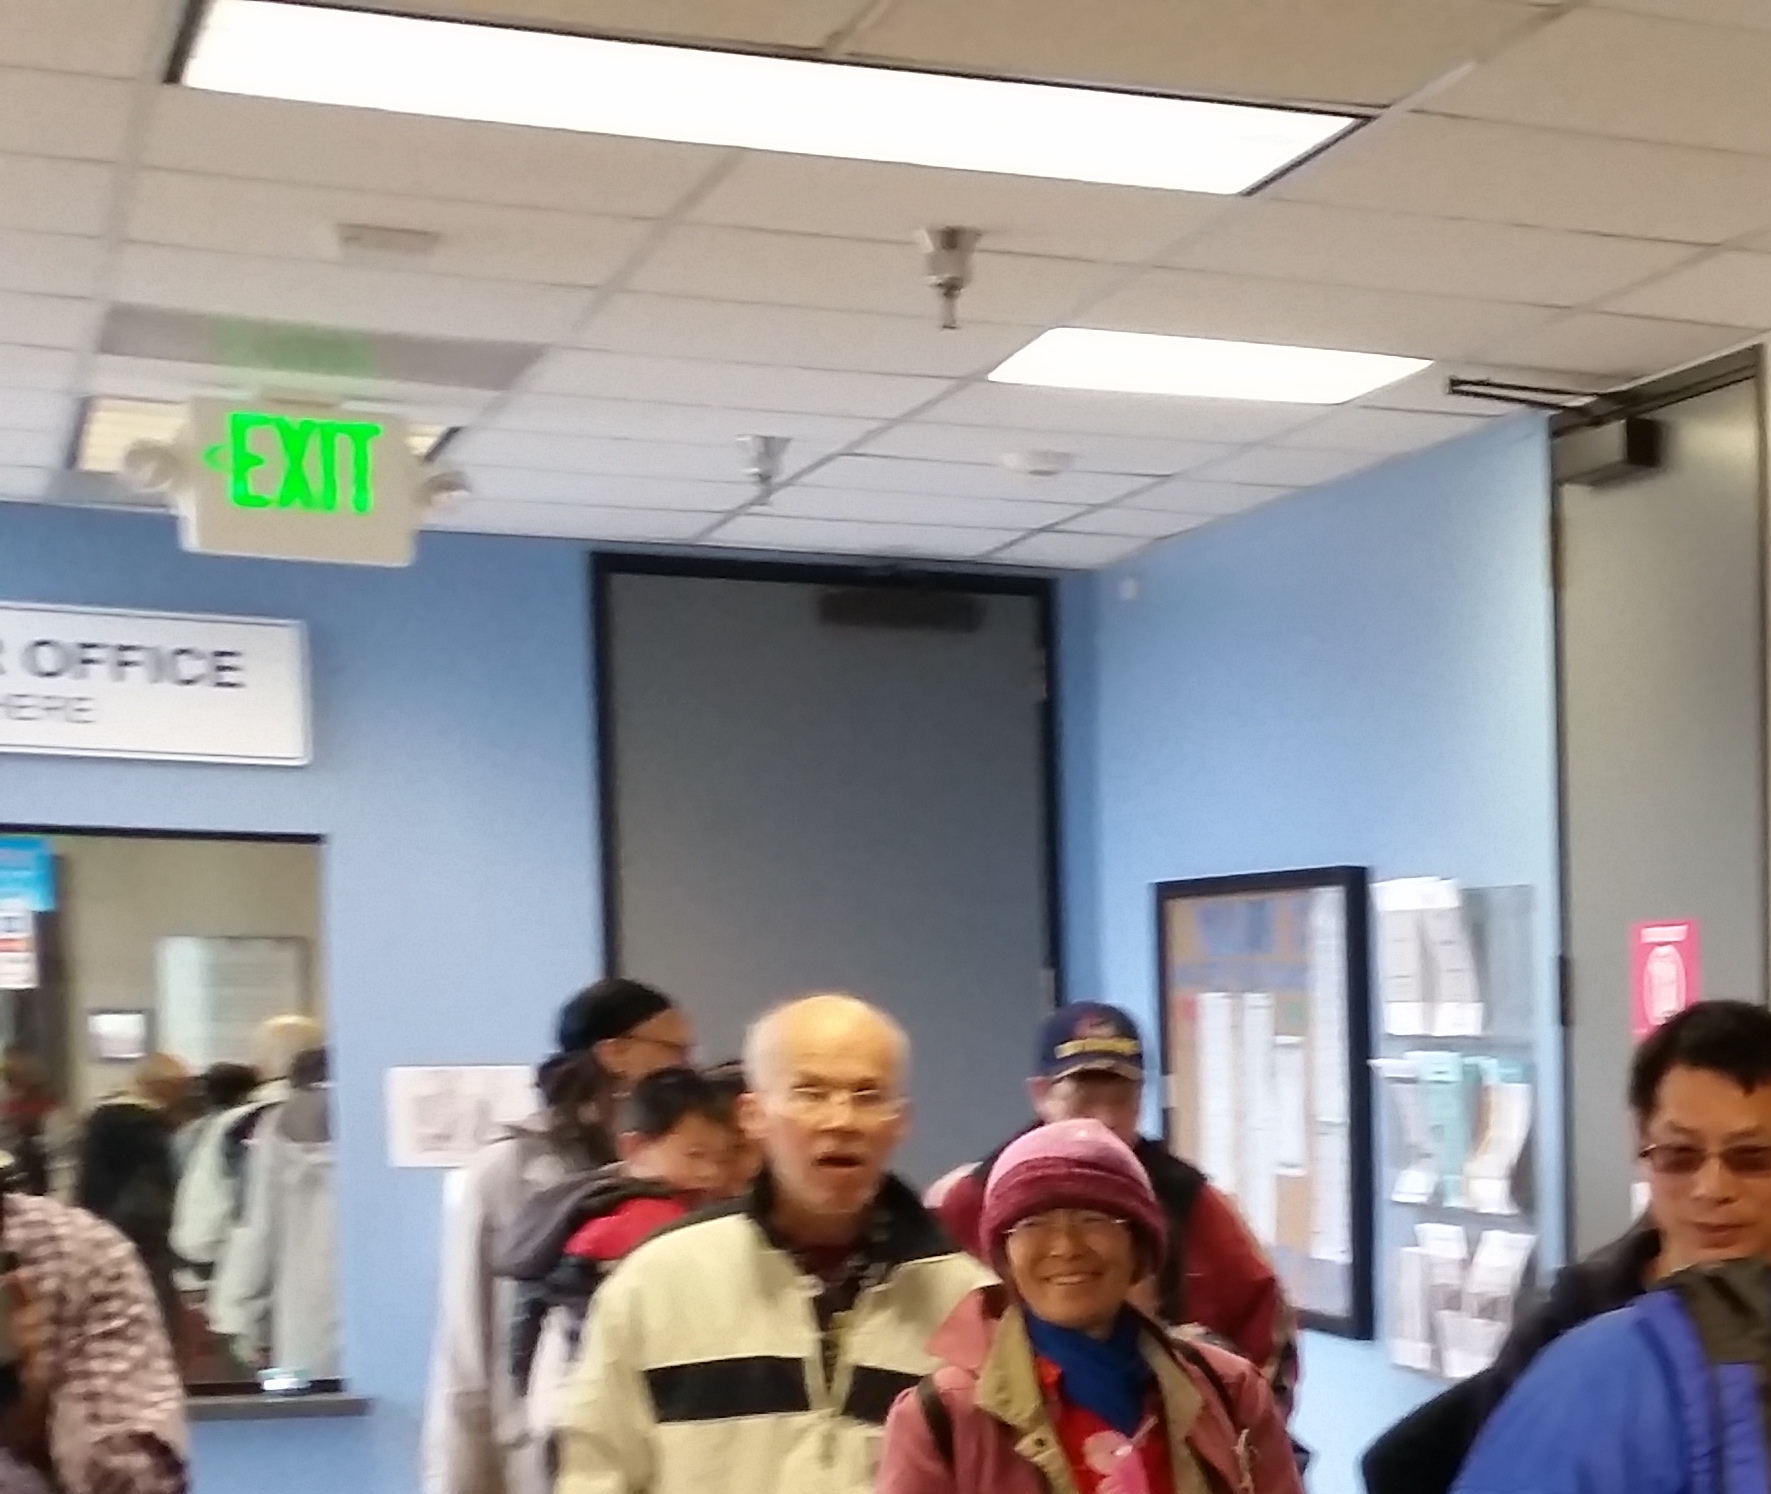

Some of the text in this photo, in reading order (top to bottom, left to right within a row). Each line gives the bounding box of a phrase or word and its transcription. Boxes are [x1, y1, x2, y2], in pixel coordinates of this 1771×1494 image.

[228, 411, 382, 514] EXIT
[21, 637, 245, 689] OFFICE
[0, 690, 97, 725] ERE
